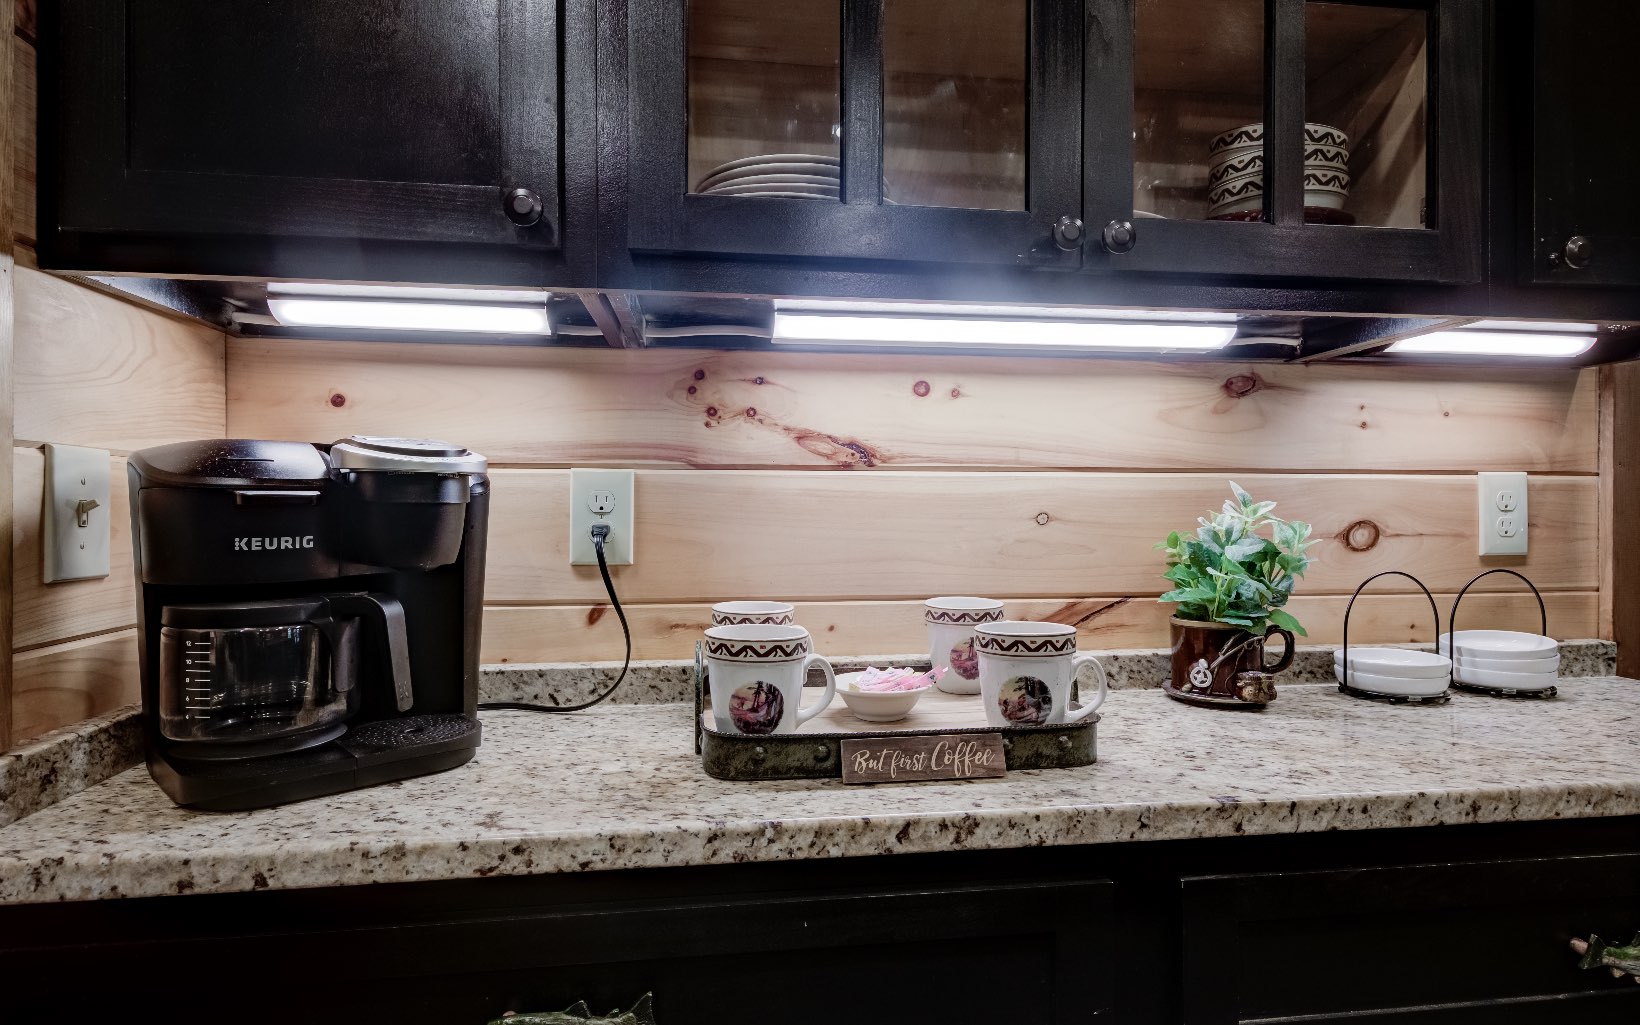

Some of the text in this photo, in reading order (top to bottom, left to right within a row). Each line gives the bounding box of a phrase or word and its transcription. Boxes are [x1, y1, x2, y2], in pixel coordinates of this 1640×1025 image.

[234, 535, 314, 551] KEURIG
[851, 741, 996, 779] But first Coffee
